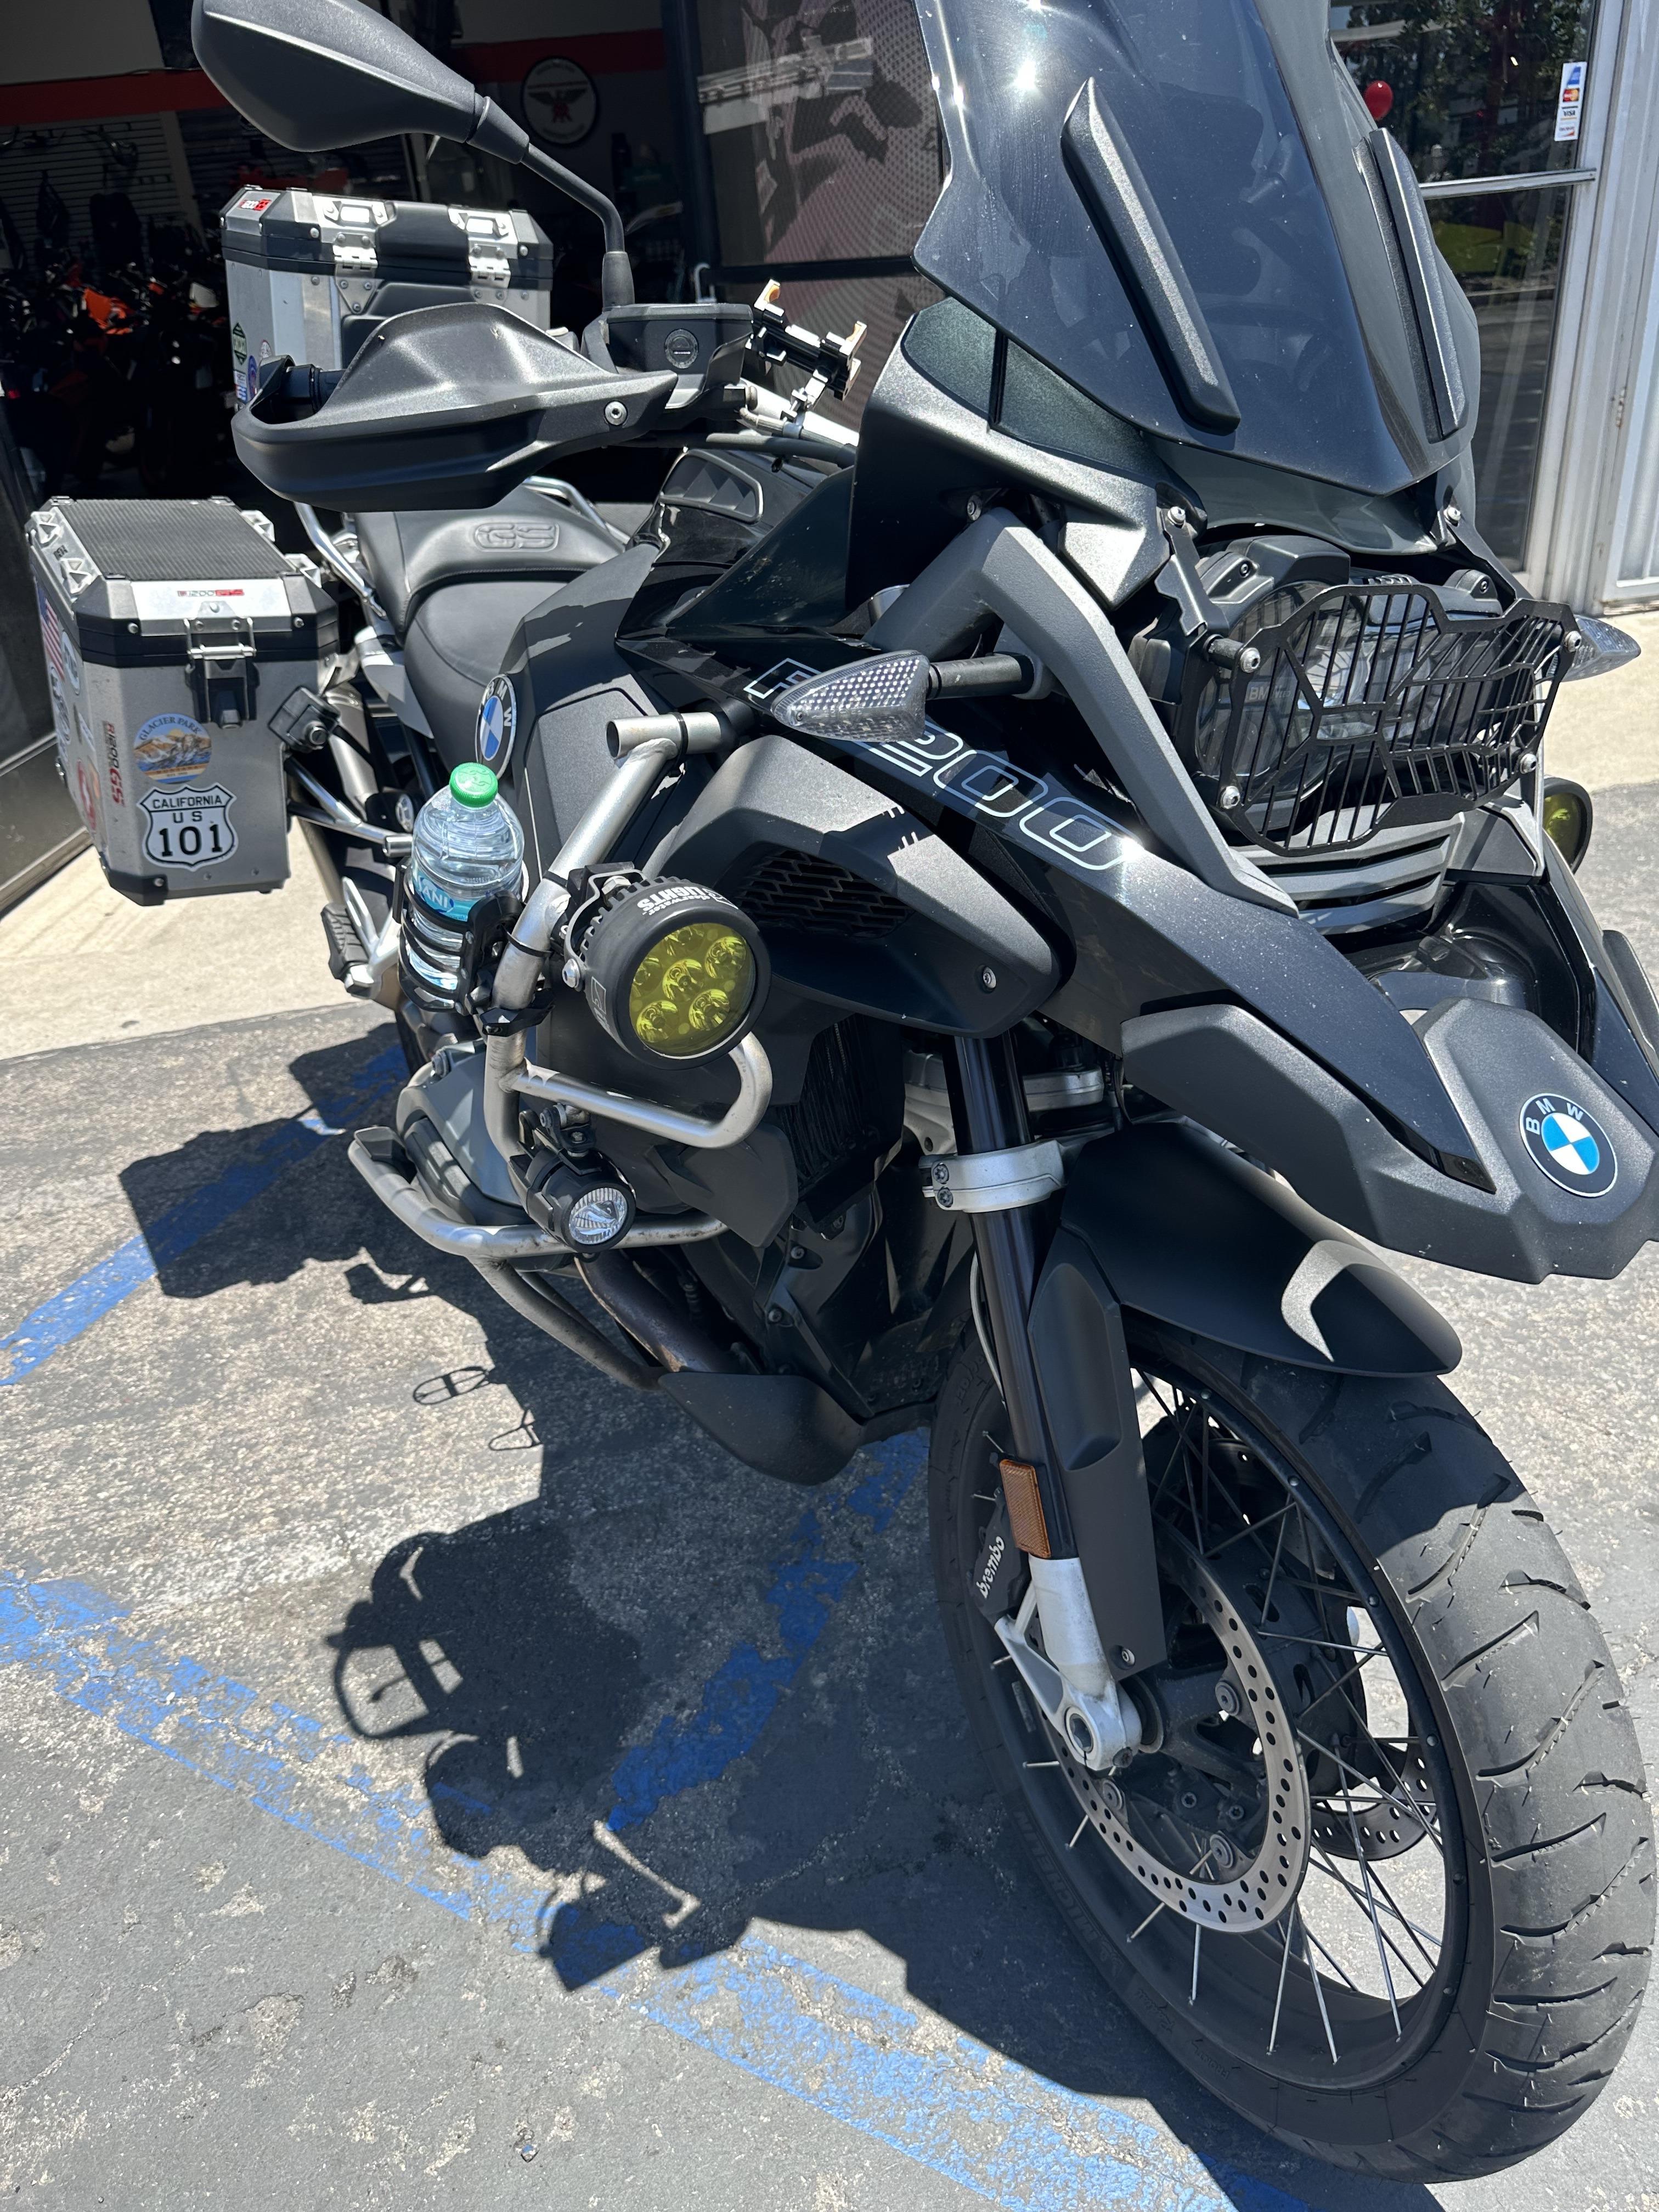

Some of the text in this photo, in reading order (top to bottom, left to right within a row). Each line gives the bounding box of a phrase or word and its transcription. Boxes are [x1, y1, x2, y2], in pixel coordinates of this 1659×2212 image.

[487, 680, 512, 727] BMW
[139, 716, 202, 741] GLACIER PARK
[153, 795, 223, 809] CALIFORNIA
[159, 824, 222, 857] 101
[637, 887, 706, 911] LIGHTS
[1526, 1098, 1584, 1135] BMW
[976, 1536, 1005, 1599] brembo
[1014, 1811, 1098, 1944] MICHELIN
